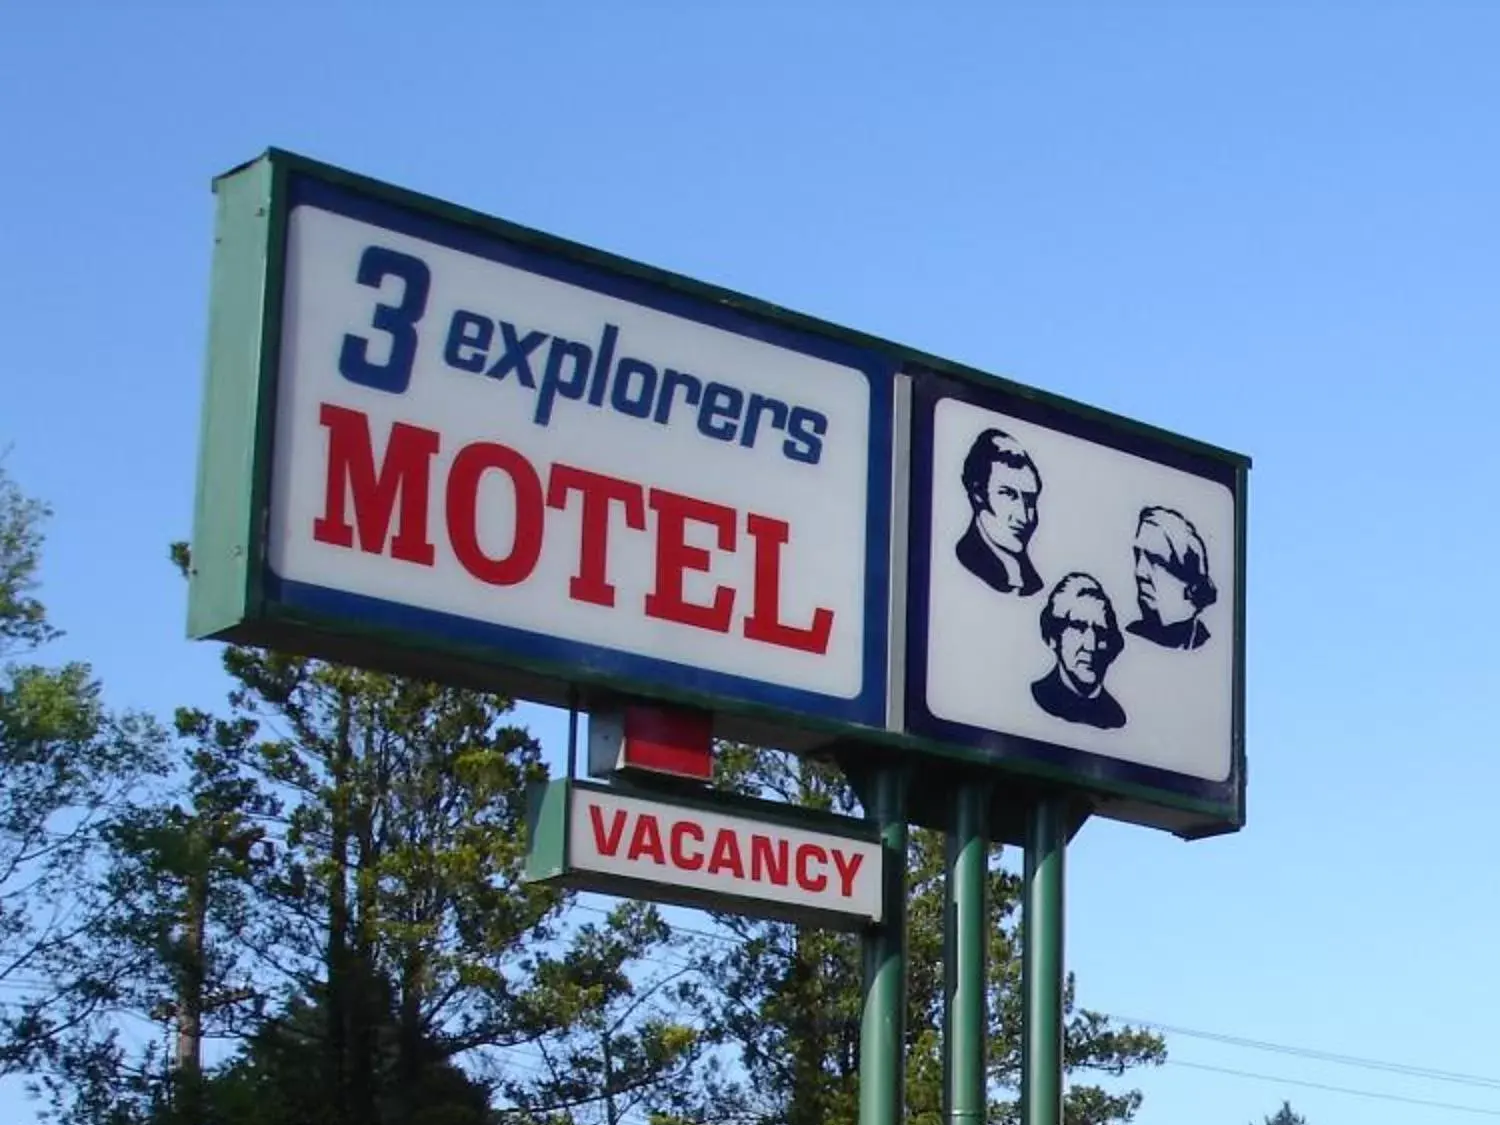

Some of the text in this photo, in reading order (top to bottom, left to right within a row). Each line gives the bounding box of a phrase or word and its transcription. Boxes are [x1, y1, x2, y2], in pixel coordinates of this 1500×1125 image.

[338, 245, 828, 465] 3 explorers
[312, 403, 836, 654] MOTEL
[588, 804, 864, 897] VACANCY
